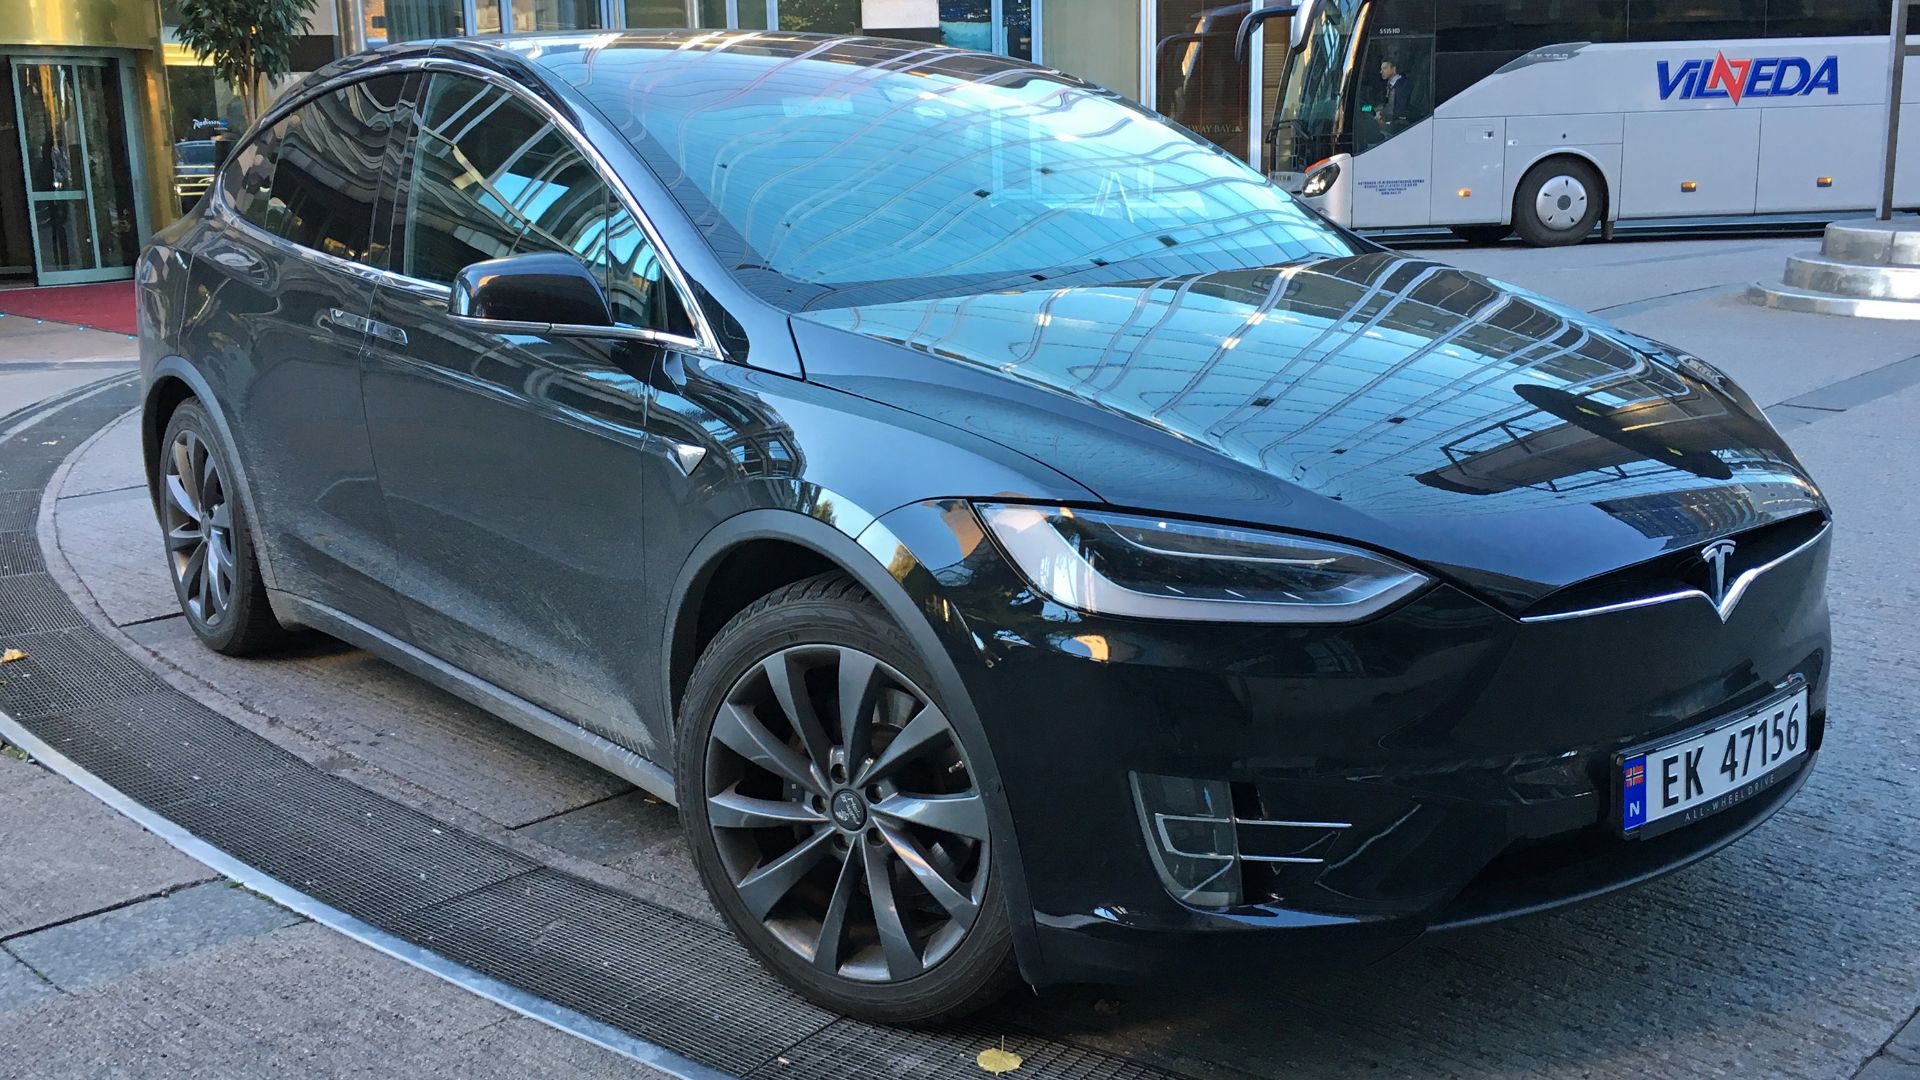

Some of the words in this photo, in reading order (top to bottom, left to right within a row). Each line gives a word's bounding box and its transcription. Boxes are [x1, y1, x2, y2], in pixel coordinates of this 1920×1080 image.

[1187, 124, 1212, 133] WAY
[1662, 746, 1704, 809] EK
[1720, 702, 1800, 782] 47156
[1748, 774, 1776, 796] DRIVE
[1629, 800, 1640, 818] N
